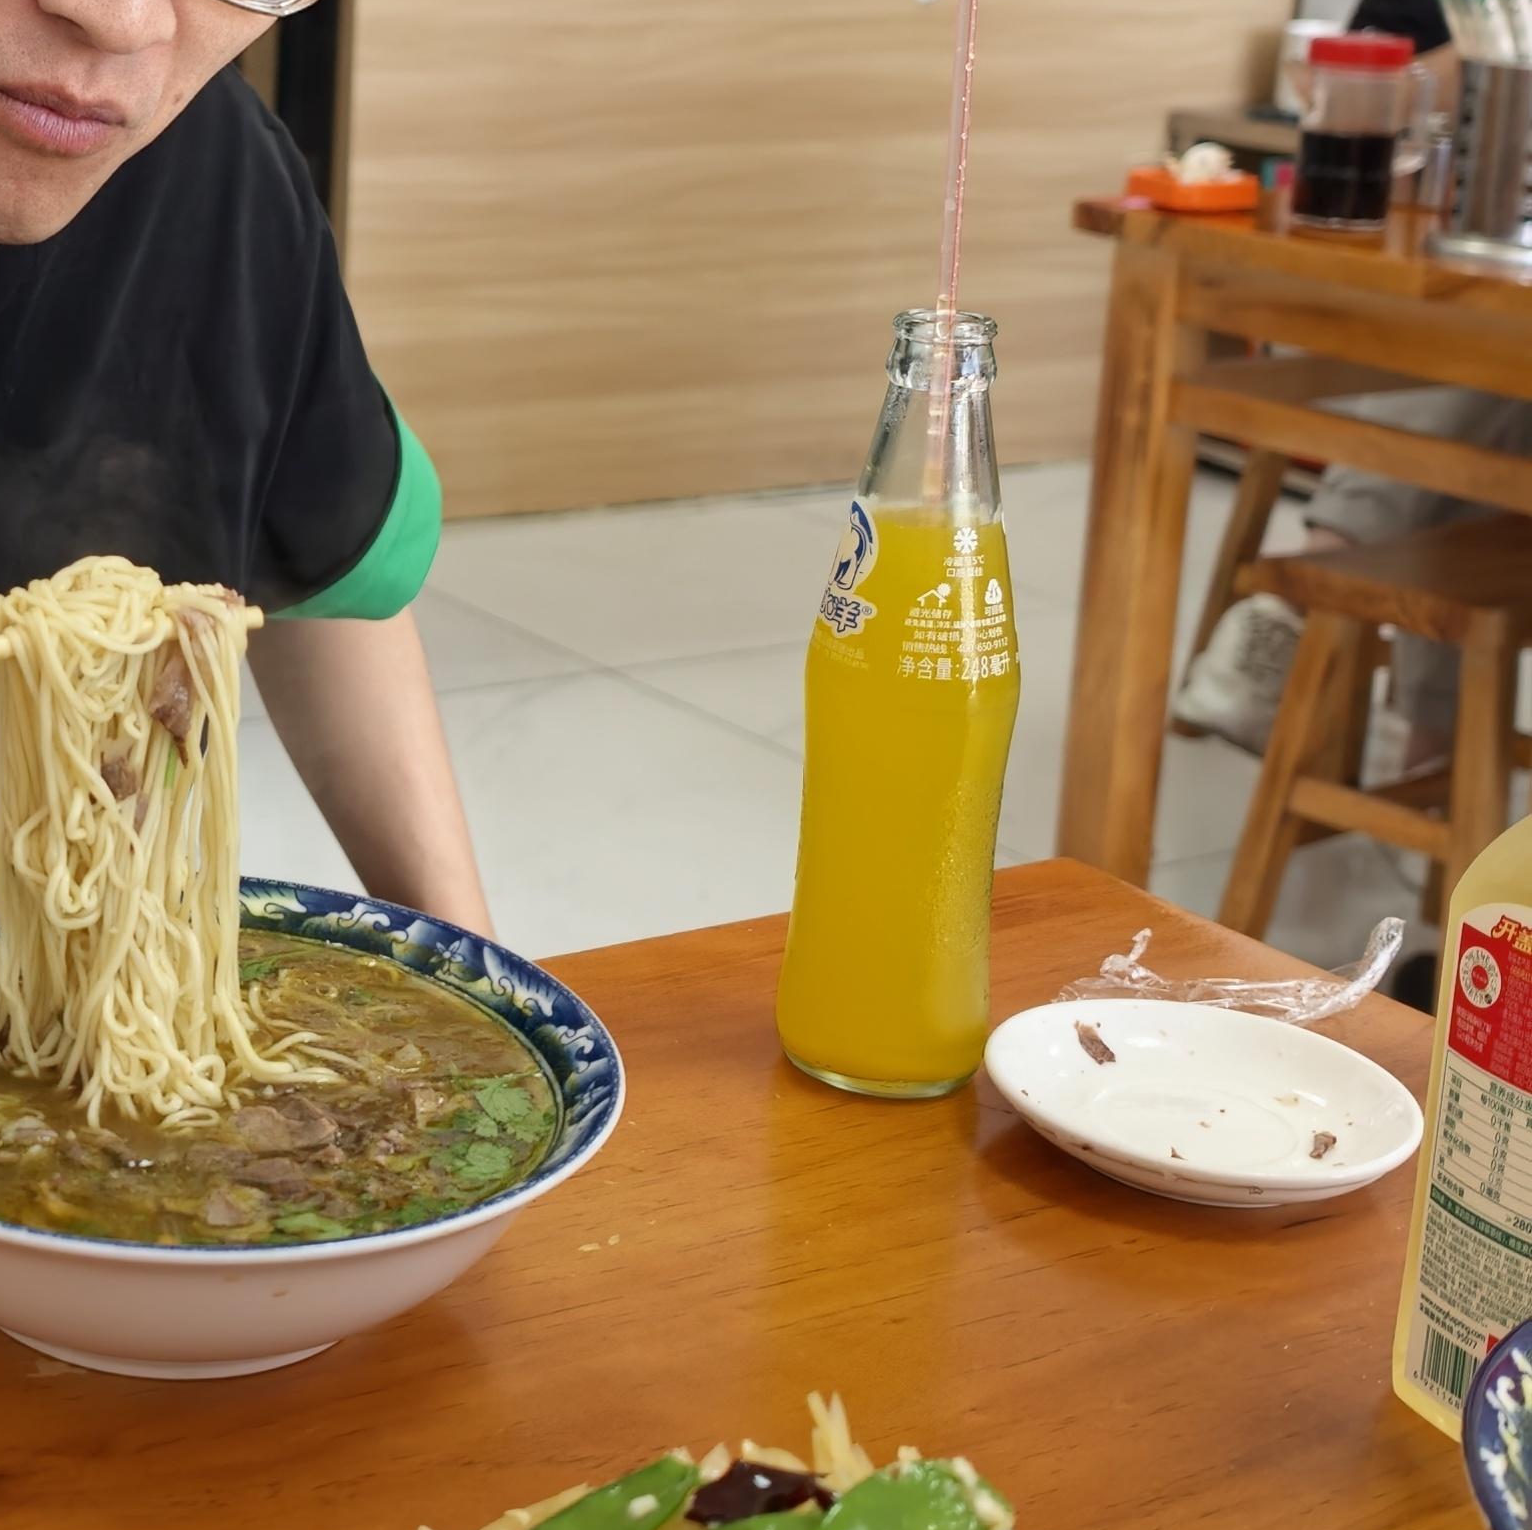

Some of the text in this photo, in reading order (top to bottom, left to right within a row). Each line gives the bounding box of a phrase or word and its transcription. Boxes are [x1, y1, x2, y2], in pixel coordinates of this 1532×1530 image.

[897, 651, 1011, 681] 净含量:248毫升
